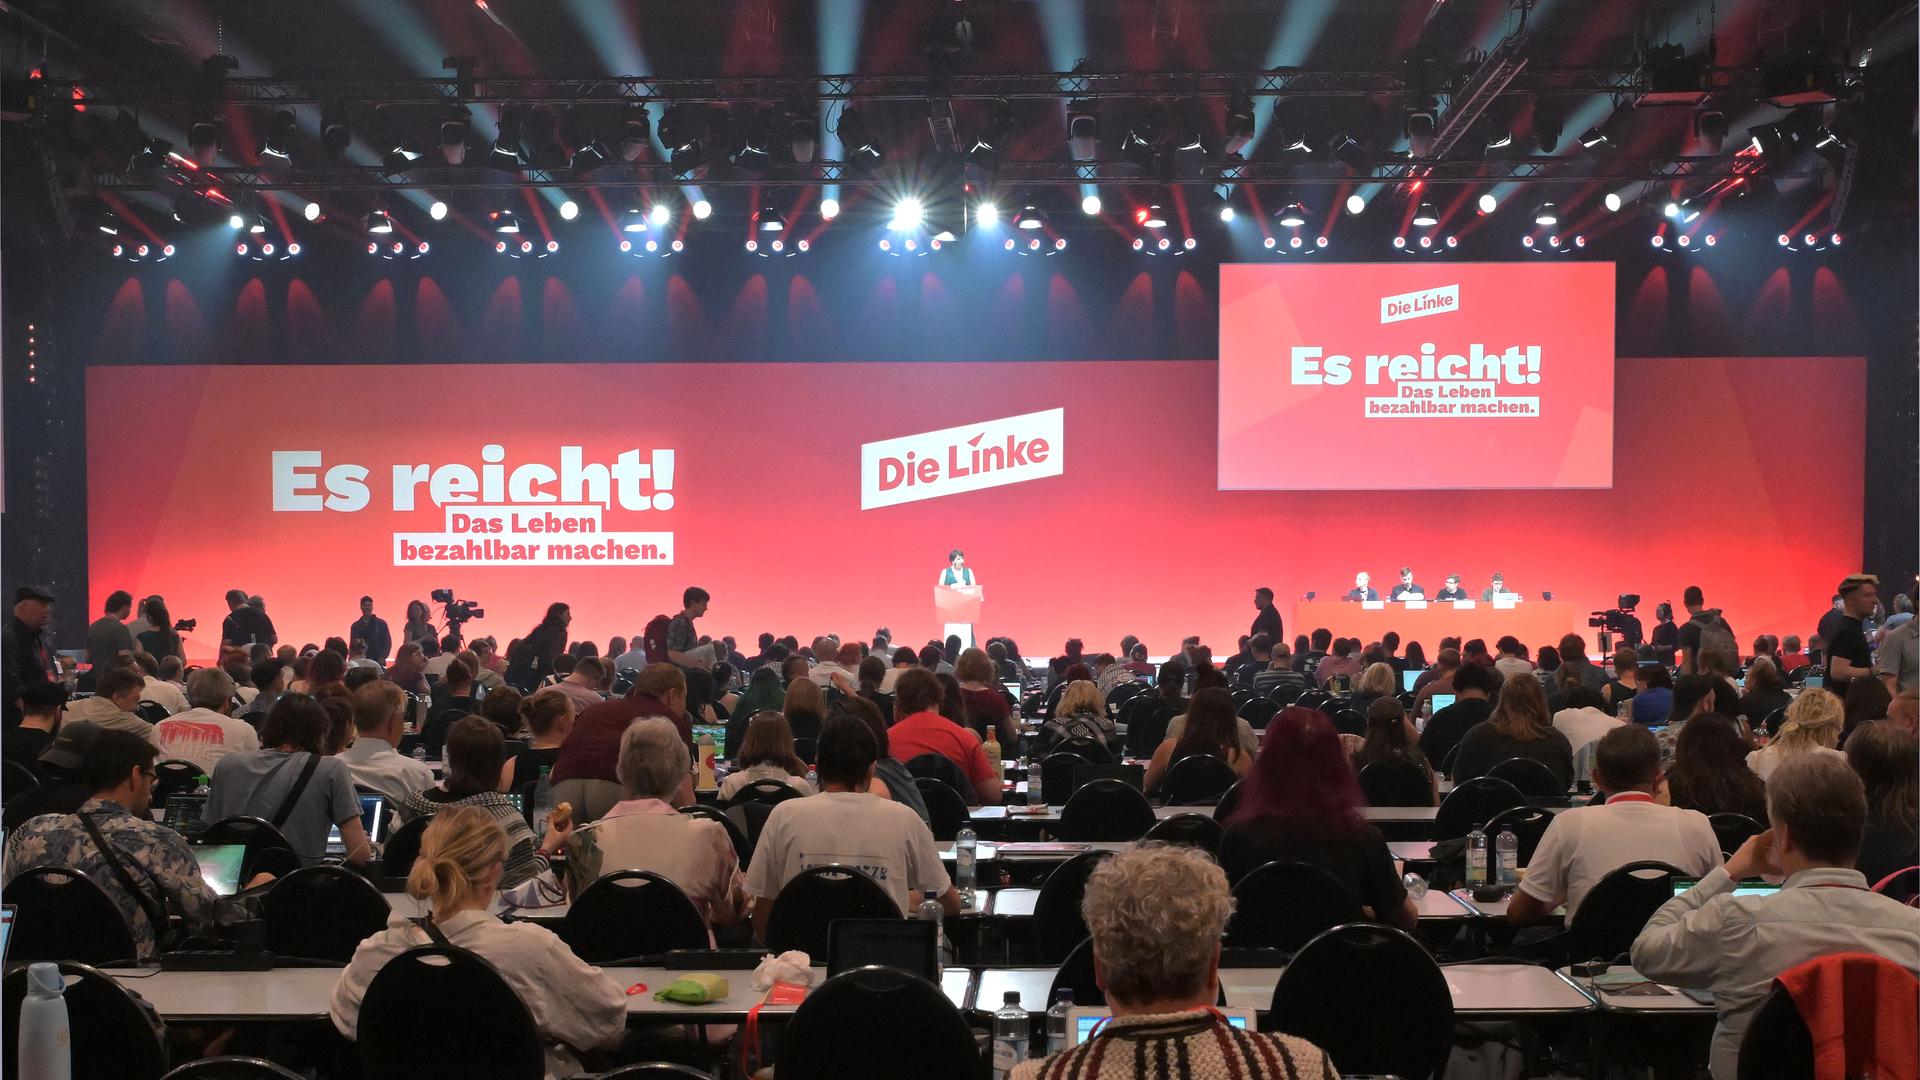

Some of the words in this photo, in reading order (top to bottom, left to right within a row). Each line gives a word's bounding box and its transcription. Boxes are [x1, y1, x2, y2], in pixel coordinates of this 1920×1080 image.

[1387, 302, 1411, 317] Die
[1414, 294, 1454, 311] Linke
[1291, 346, 1352, 386] Es
[1365, 342, 1542, 385] reicht!
[1401, 385, 1433, 398] Das
[1438, 385, 1491, 398] Leben
[1369, 401, 1456, 414] bezahlbar
[1460, 401, 1535, 414] machen.
[879, 450, 940, 492] Die
[948, 431, 1050, 479] Linke
[272, 450, 371, 512] Es
[392, 444, 675, 511] reicht!
[452, 513, 503, 534] Das
[511, 513, 597, 534] Leben
[400, 539, 540, 561] bezahlbar
[547, 539, 667, 561] machen.
